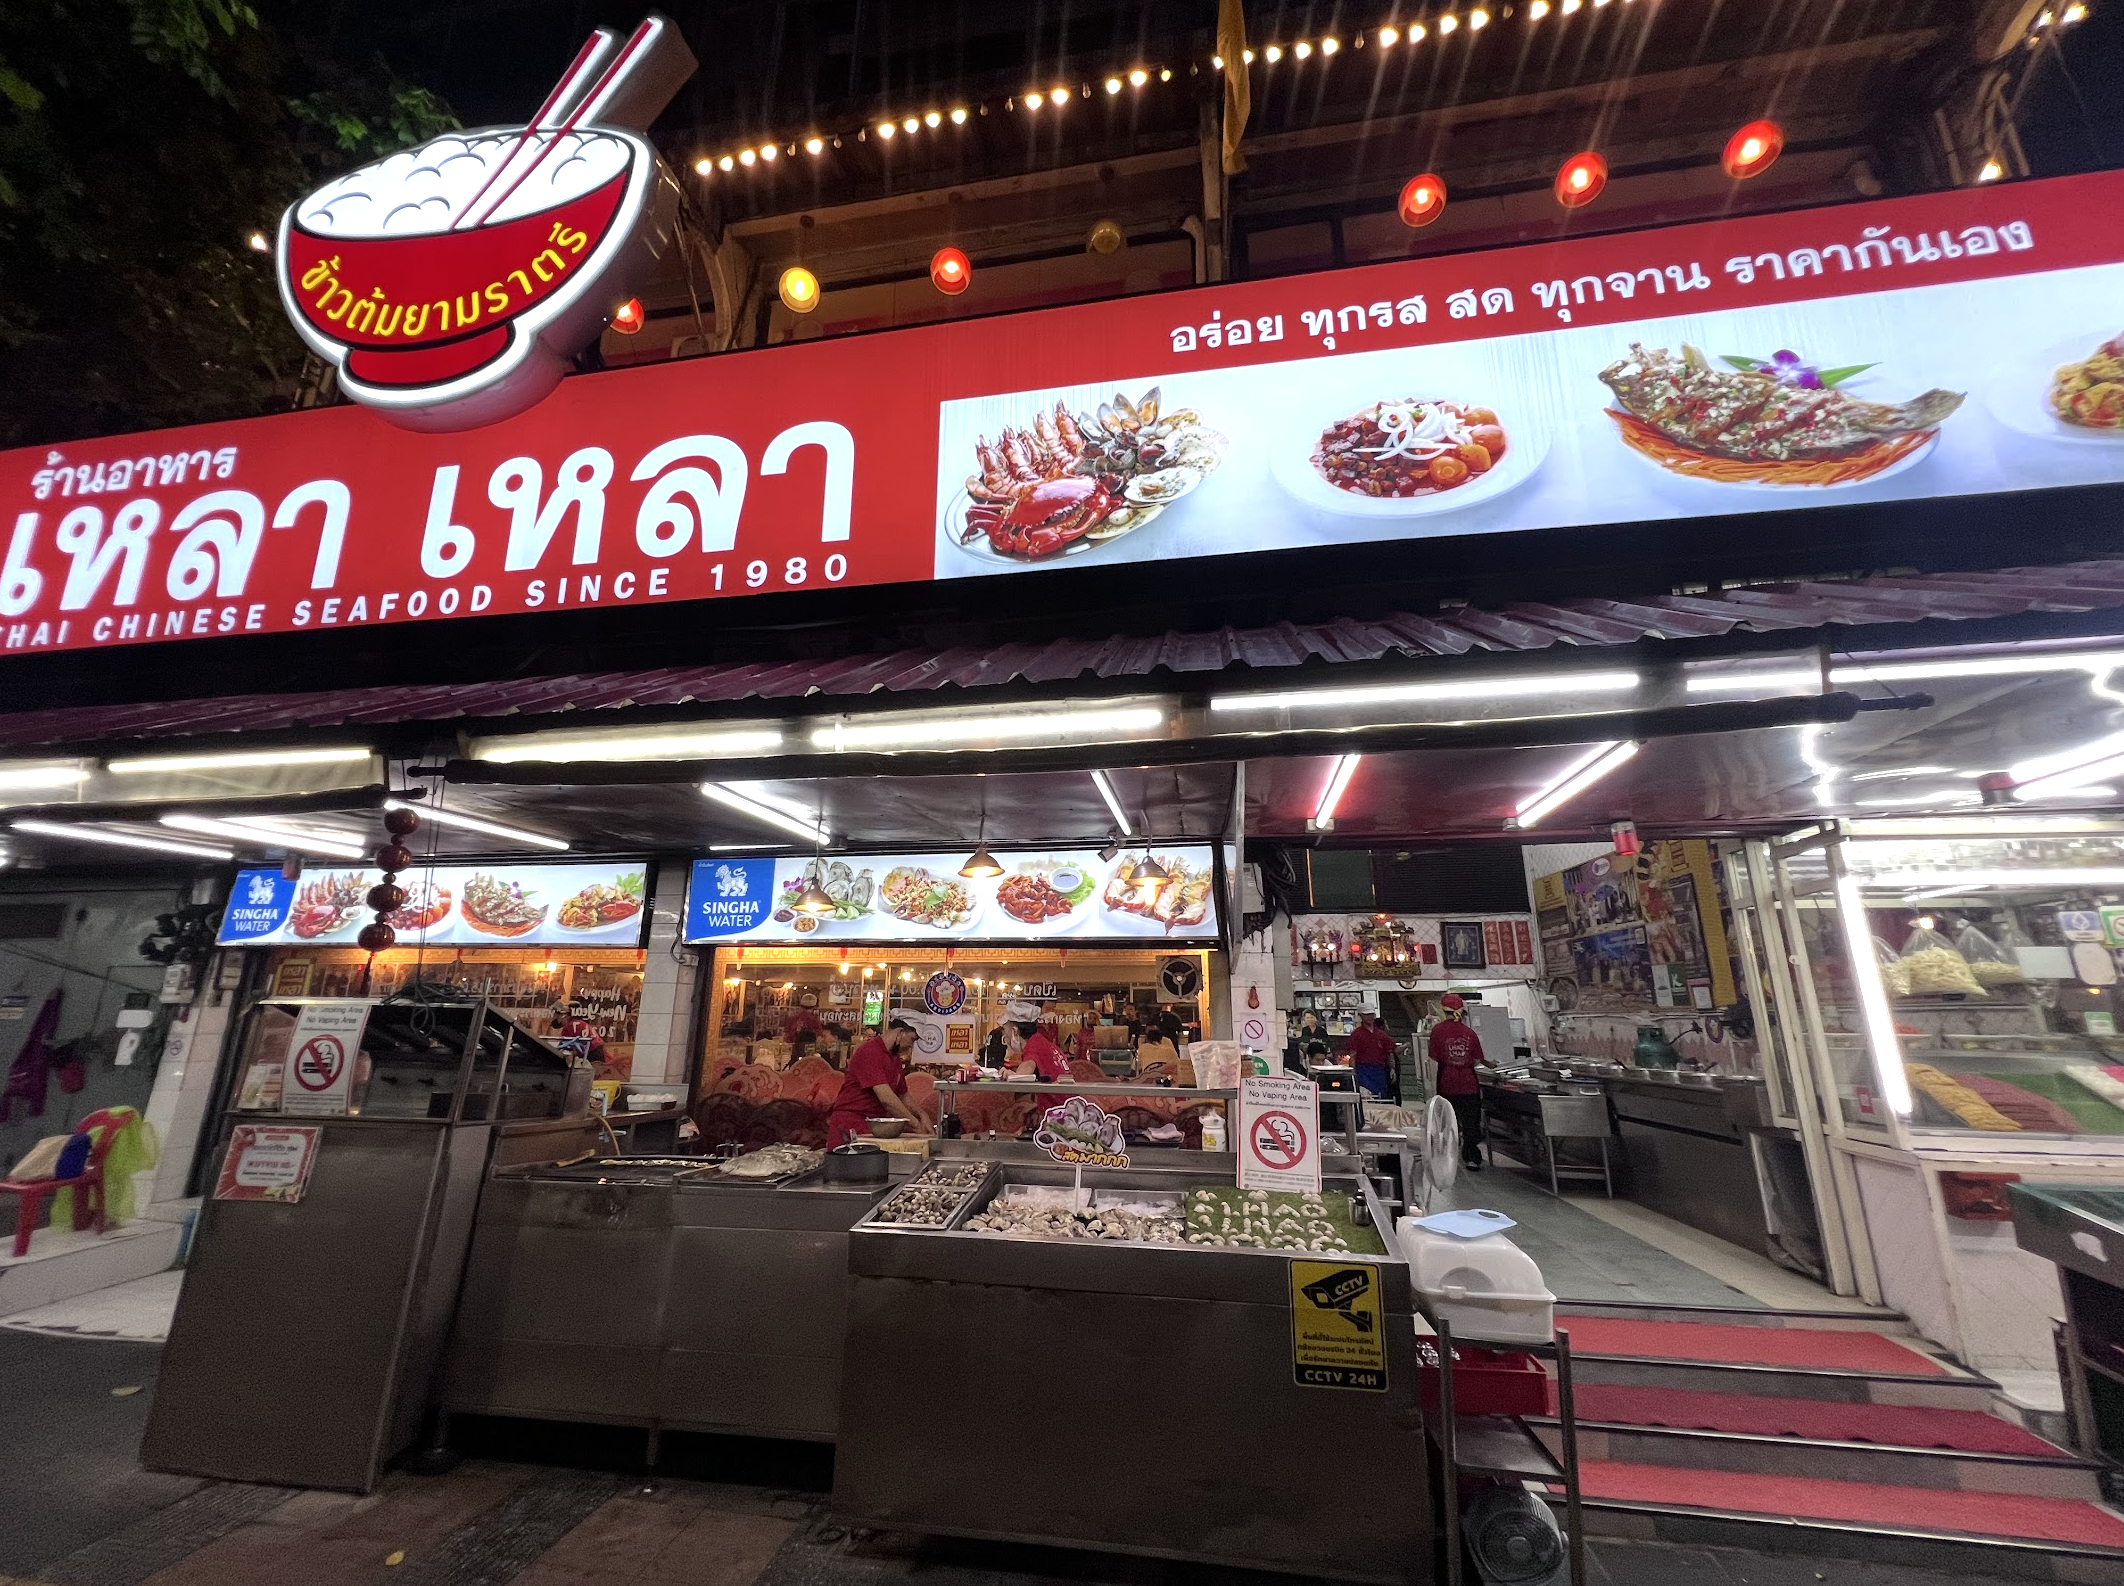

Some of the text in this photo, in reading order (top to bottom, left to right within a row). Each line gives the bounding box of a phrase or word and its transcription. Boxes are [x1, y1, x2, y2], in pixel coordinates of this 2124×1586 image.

[300, 221, 588, 337] ข้าวต้มยามราตรี
[1169, 220, 2034, 353] อร่อย ทุกรส สด ทุกจาน ราคากันเอง
[31, 446, 238, 500] ร้านอาหาร
[0, 420, 855, 617] เหลา เหลา
[0, 554, 848, 649] HAI CHINESE SEAFOOD SINCE 1980
[231, 908, 278, 920] SINGHA
[702, 901, 760, 914] SINGHA
[234, 921, 271, 931] WATER
[708, 915, 752, 927] WATER
[320, 1006, 347, 1015] Smoking
[348, 1006, 363, 1014] Area
[341, 1016, 357, 1024] Area
[1245, 1079, 1311, 1091] No Smoking Area
[1248, 1090, 1308, 1101] No Vaping Area
[1334, 1275, 1364, 1296] CCTV
[1304, 1369, 1378, 1386] CCTV 24H
